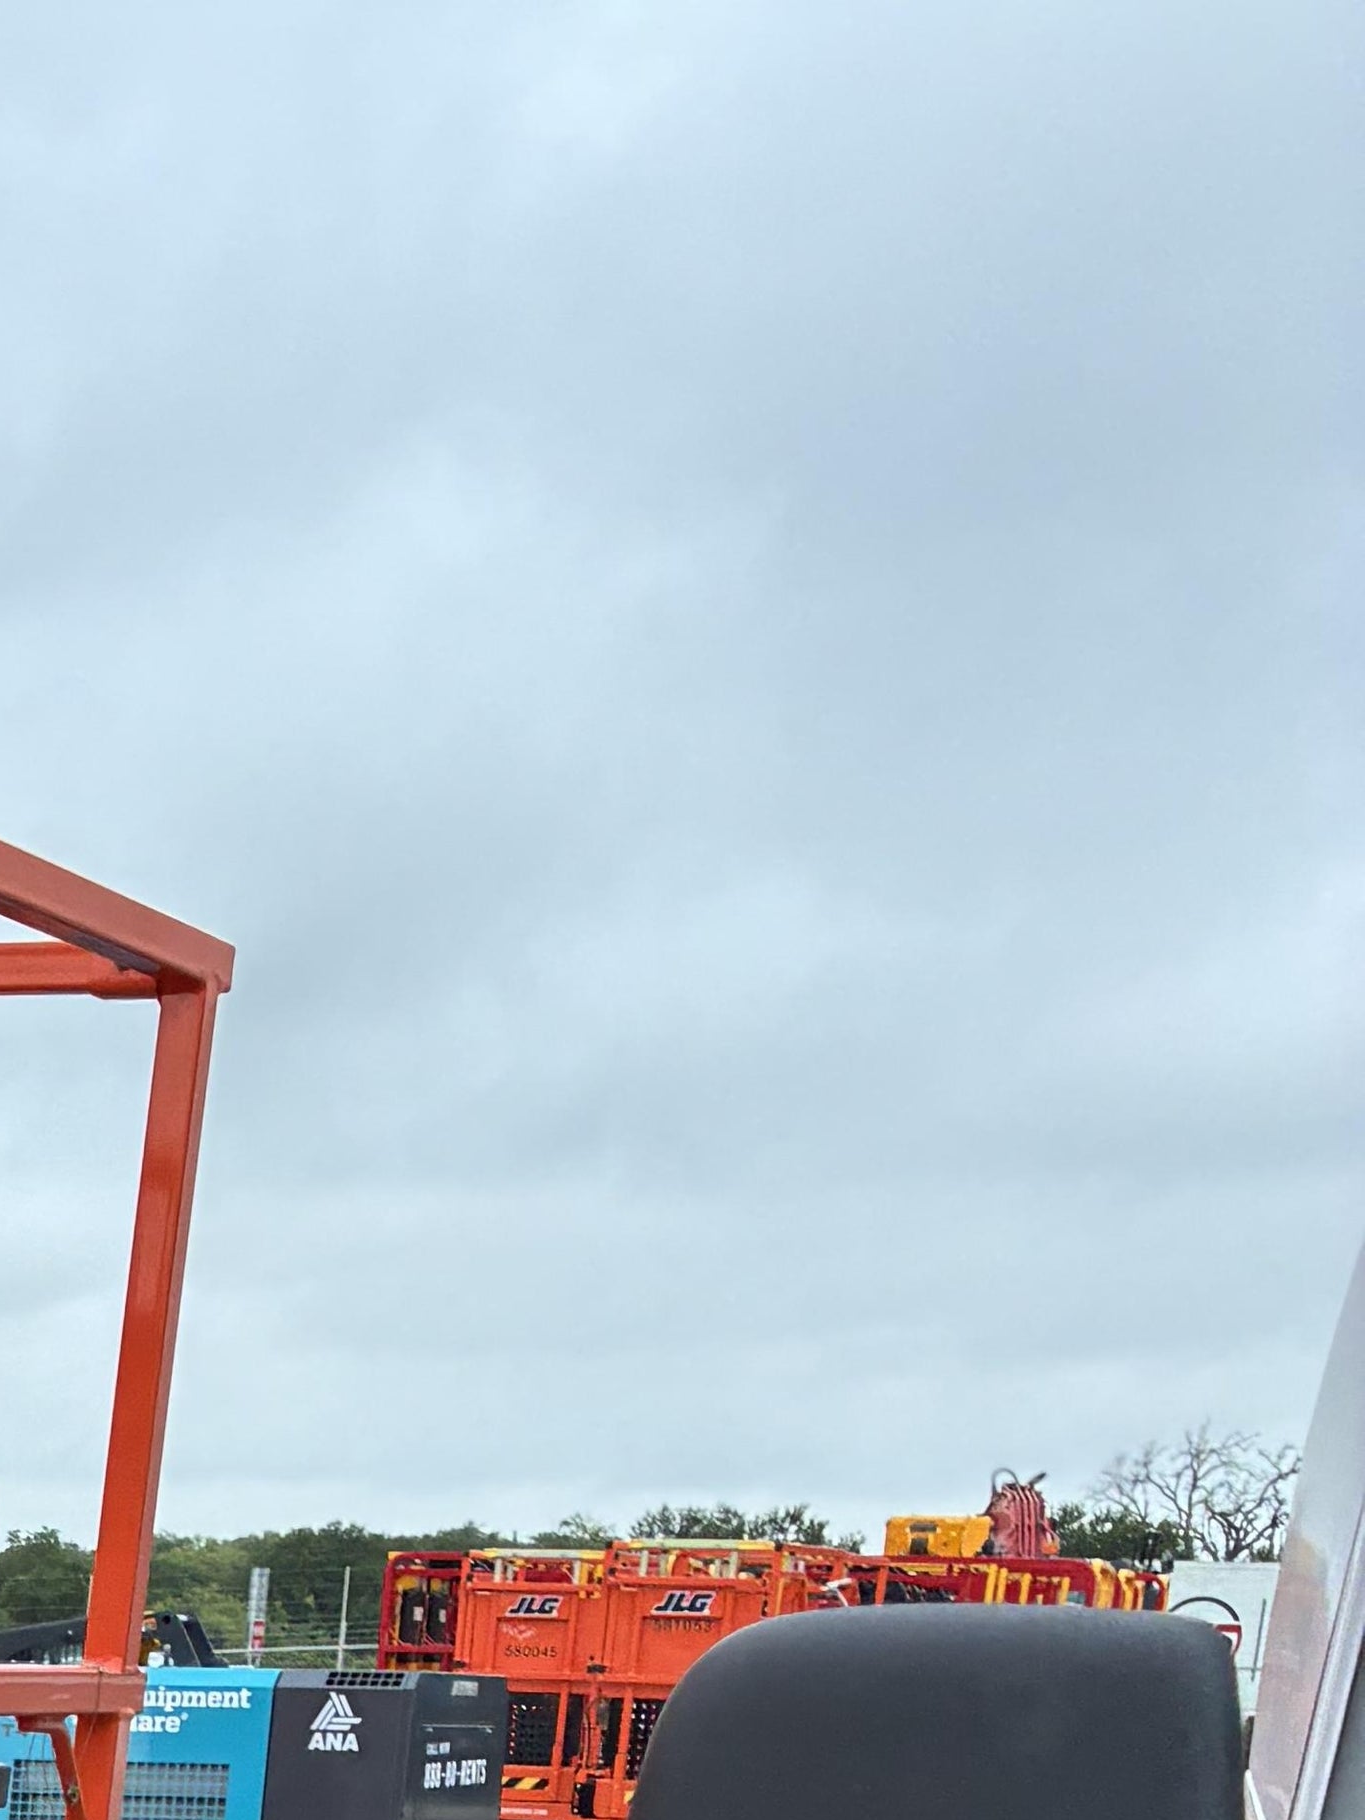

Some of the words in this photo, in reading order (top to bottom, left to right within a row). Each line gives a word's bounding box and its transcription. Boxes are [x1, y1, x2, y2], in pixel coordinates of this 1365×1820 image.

[507, 1596, 562, 1616] JLG
[652, 1592, 715, 1614] JLG
[143, 1686, 252, 1711] uipment
[307, 1732, 359, 1752] ANA
